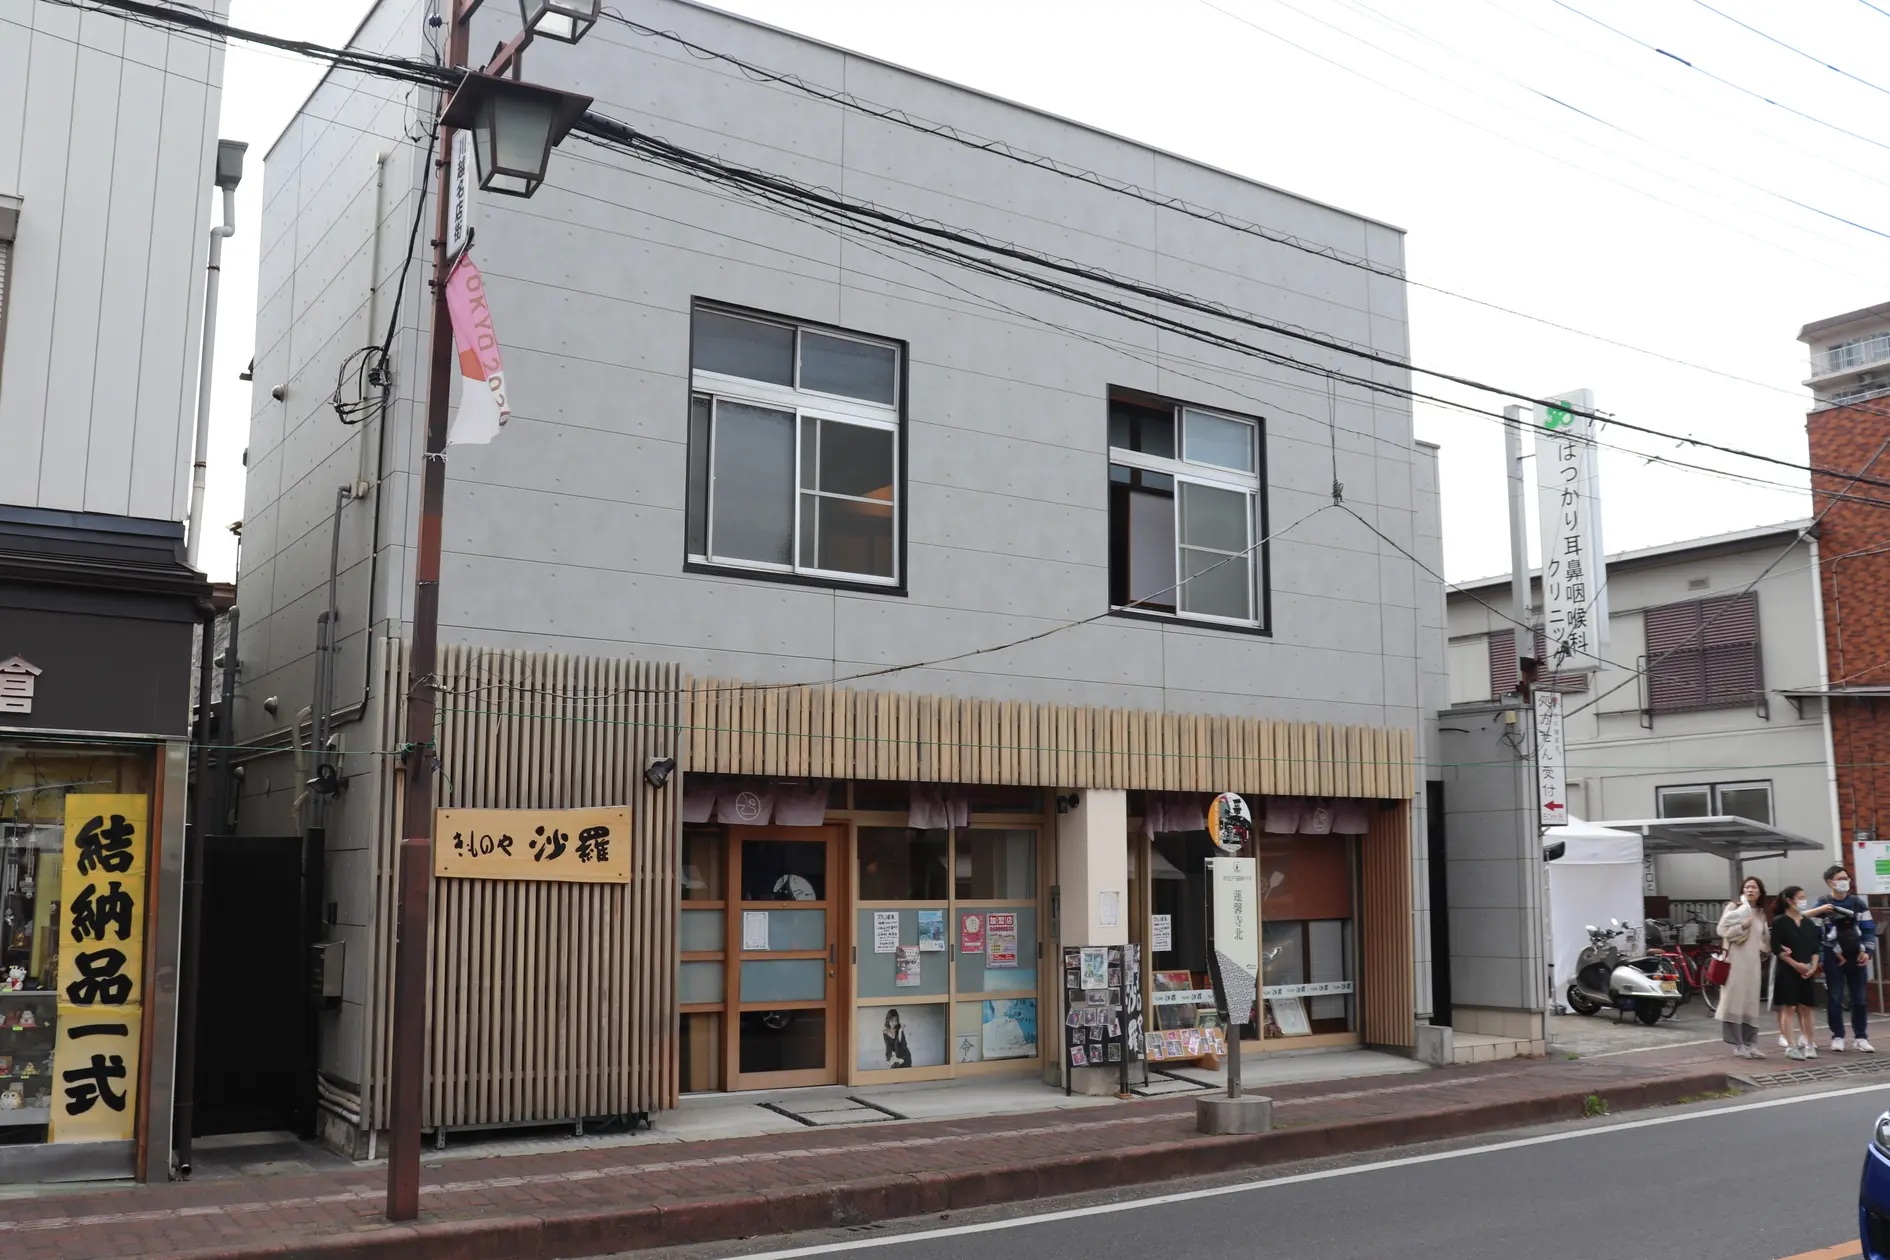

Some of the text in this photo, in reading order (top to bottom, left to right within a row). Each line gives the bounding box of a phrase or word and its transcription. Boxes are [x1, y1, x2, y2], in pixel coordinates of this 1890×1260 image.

[1558, 441, 1589, 653] はつかり耳鼻咽喉科
[1548, 558, 1568, 669] クリニック
[1538, 695, 1556, 798] 処方せん受付
[452, 825, 611, 864] きものや 沙羅
[63, 814, 135, 1116] 結納品一式
